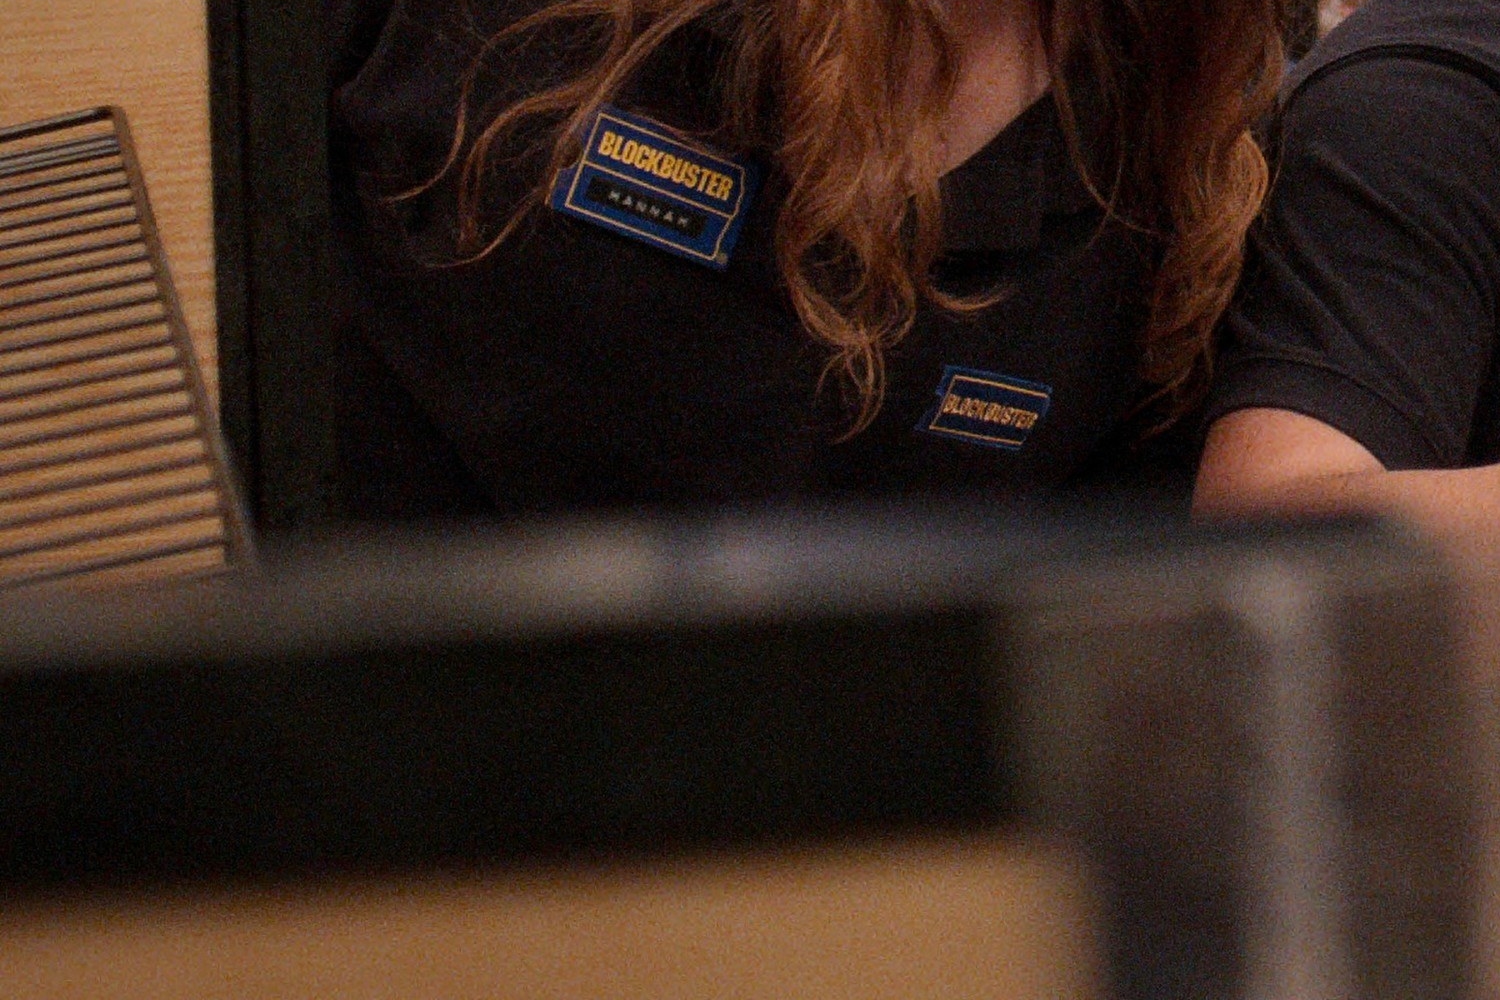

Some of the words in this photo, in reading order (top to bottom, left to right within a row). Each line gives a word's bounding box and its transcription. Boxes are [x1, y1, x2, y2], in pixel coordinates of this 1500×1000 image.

[598, 131, 734, 200] BLOCKBUSTER
[608, 189, 689, 227] HANNAH
[942, 393, 1039, 430] BLOCKBUSTER
